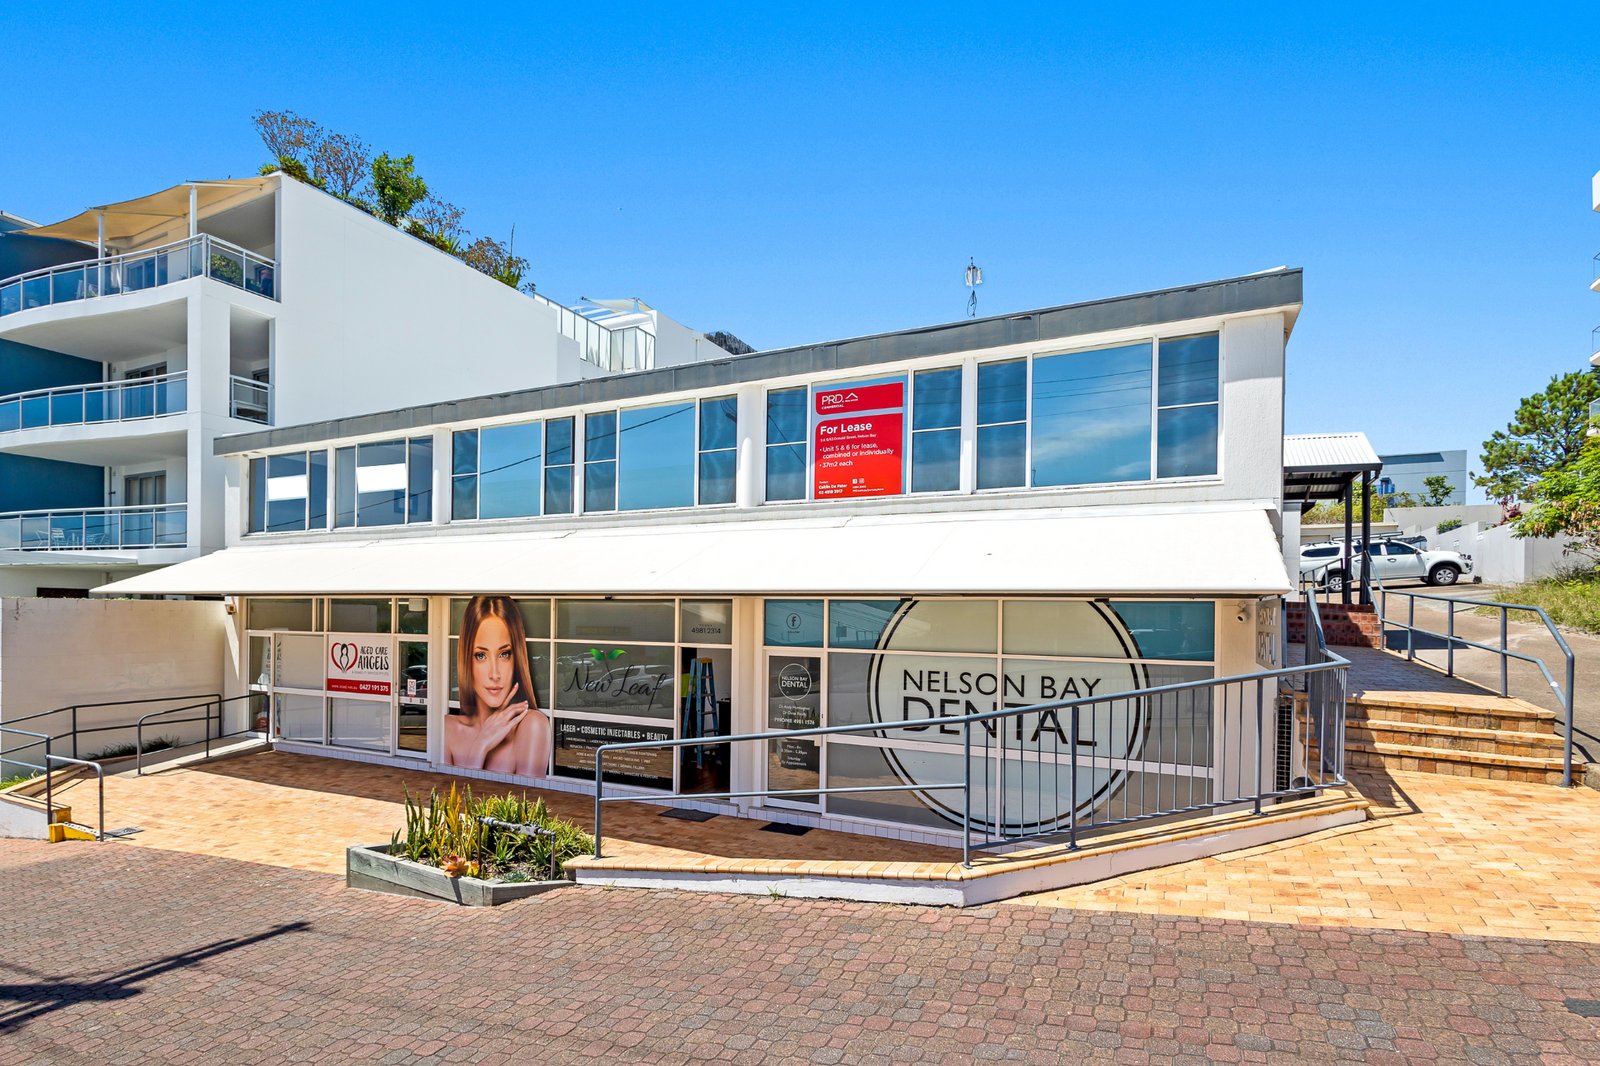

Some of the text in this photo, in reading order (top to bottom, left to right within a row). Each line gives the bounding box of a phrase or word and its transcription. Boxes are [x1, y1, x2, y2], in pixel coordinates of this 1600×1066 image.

[820, 423, 872, 435] For Lease
[860, 448, 894, 456] individually
[360, 646, 388, 655] AGED CARE
[358, 656, 389, 670] ANGELS
[564, 664, 666, 711] New Leaf
[781, 680, 808, 688] DENTAL
[903, 670, 1102, 699] NELSON BAY
[903, 696, 1097, 746] DENTAL
[560, 724, 668, 741] LASER COSMETIC INJECTABLES BEAUTY
